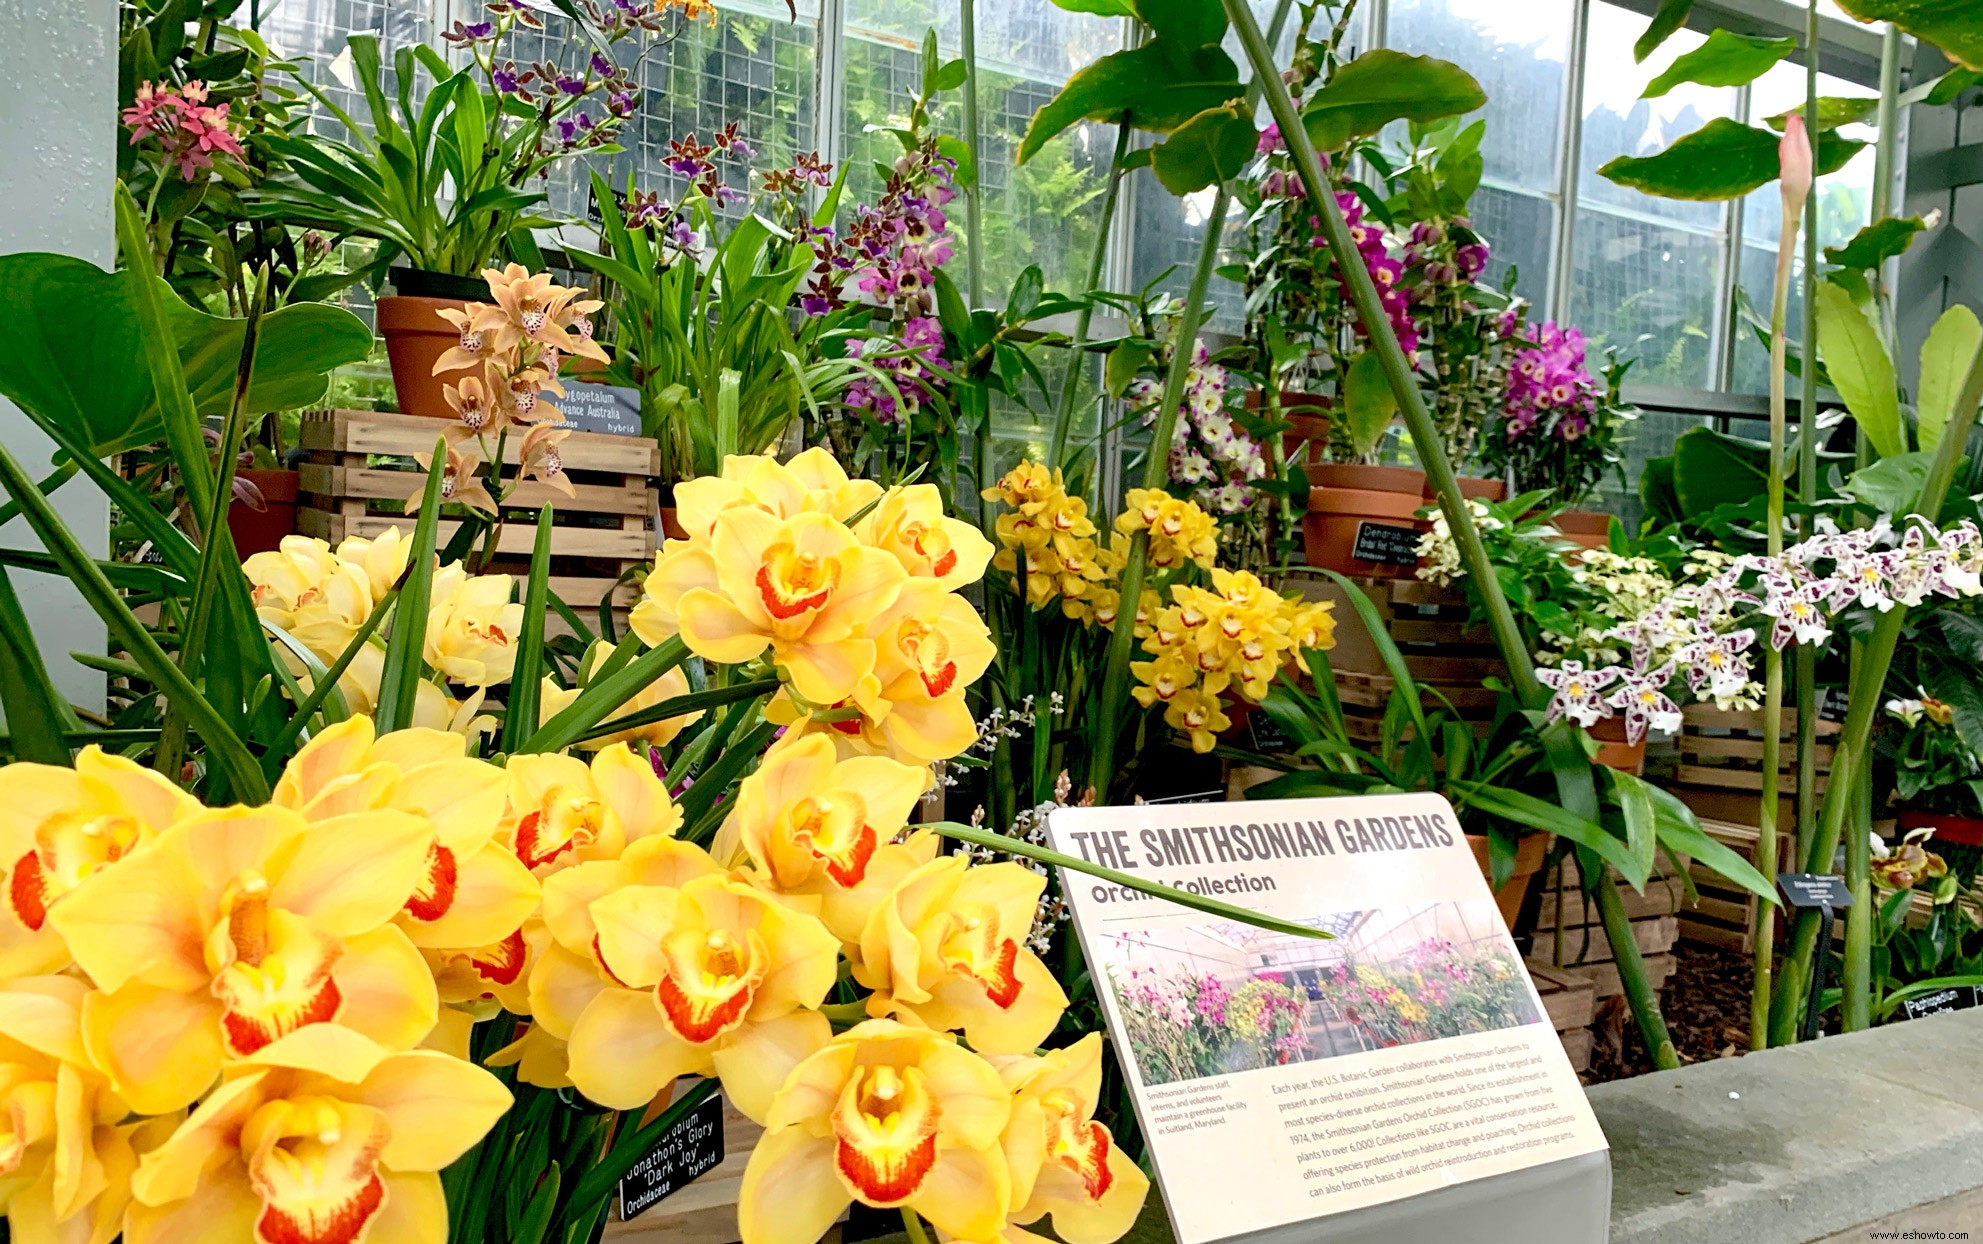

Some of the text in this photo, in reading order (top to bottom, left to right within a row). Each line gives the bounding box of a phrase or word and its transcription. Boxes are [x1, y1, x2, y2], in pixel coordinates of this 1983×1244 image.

[555, 401, 620, 420] Advance Australia
[565, 389, 615, 404] ygopetalum
[607, 422, 635, 433] hybrid
[1070, 813, 1454, 869] THE SMITHSONIAN GARDENS
[1091, 880, 1164, 904] Orc
[1147, 1089, 1186, 1100] Smithsonian
[1187, 1085, 1214, 1093] Gardens
[1272, 1084, 1291, 1094] Each
[1292, 1083, 1311, 1093] year,
[1311, 1079, 1323, 1087] the
[1324, 1075, 1340, 1085] U.S.
[1340, 1072, 1368, 1082] Botanic
[1369, 1067, 1395, 1077] Garden
[1396, 1060, 1438, 1072] collaborates
[1438, 1056, 1453, 1064] with
[1453, 1050, 1494, 1062] Smithsonian
[1494, 1045, 1522, 1054] Gardens
[1279, 1099, 1308, 1112] present
[1320, 1092, 1343, 1104] orchid
[1381, 1079, 1424, 1092] Smithsonian
[1425, 1073, 1455, 1083] Gardens
[1487, 1064, 1495, 1072] of
[1530, 1056, 1542, 1064] and
[1154, 1114, 1183, 1123] maintain
[1189, 1106, 1225, 1119] greenhouse
[1226, 1102, 1247, 1110] facility
[1176, 1099, 1188, 1107] and
[1189, 1095, 1222, 1105] volunteers
[1285, 1117, 1305, 1128] most
[1306, 1108, 1362, 1125] species-diverse
[1364, 1101, 1386, 1113] orchid
[1387, 1095, 1425, 1108] collections
[1467, 1084, 1486, 1092] Since
[1496, 1072, 1541, 1087] establishment
[1290, 1134, 1311, 1144] 1974,
[1312, 1132, 1325, 1141] the
[1326, 1124, 1372, 1138] Smithsonian
[1372, 1117, 1403, 1129] Gardens
[1403, 1110, 1427, 1122] Orchid
[1428, 1105, 1463, 1117] Collection
[1463, 1097, 1490, 1110] (SGOC)
[1504, 1093, 1524, 1103] grown
[626, 1121, 713, 1180] Jonathon's Glory
[1297, 1151, 1321, 1164] plants
[1332, 1147, 1347, 1155] over
[1350, 1139, 1374, 1152] 6,000!
[1376, 1132, 1416, 1146] Collections
[1429, 1122, 1452, 1134] SGOC
[1470, 1115, 1485, 1125] vital
[1486, 1109, 1527, 1122] conservation
[1528, 1103, 1558, 1113] resource,
[1303, 1115, 1575, 1179] offering species protection from habitat change and poaching. Orchid collections
[626, 1150, 716, 1214] Orchidaceae hybrid
[643, 1142, 699, 1186] 'Dark Joy'
[1310, 1188, 1324, 1197] can
[1326, 1184, 1341, 1194] also
[1342, 1181, 1361, 1190] form
[1362, 1178, 1375, 1186] the
[1375, 1173, 1395, 1183] basis
[1396, 1168, 1404, 1178] of
[1405, 1165, 1420, 1175] wild
[1421, 1159, 1443, 1172] orchid
[1444, 1150, 1492, 1165] reintroduction
[1493, 1146, 1506, 1155] and
[1507, 1139, 1542, 1151] restoration
